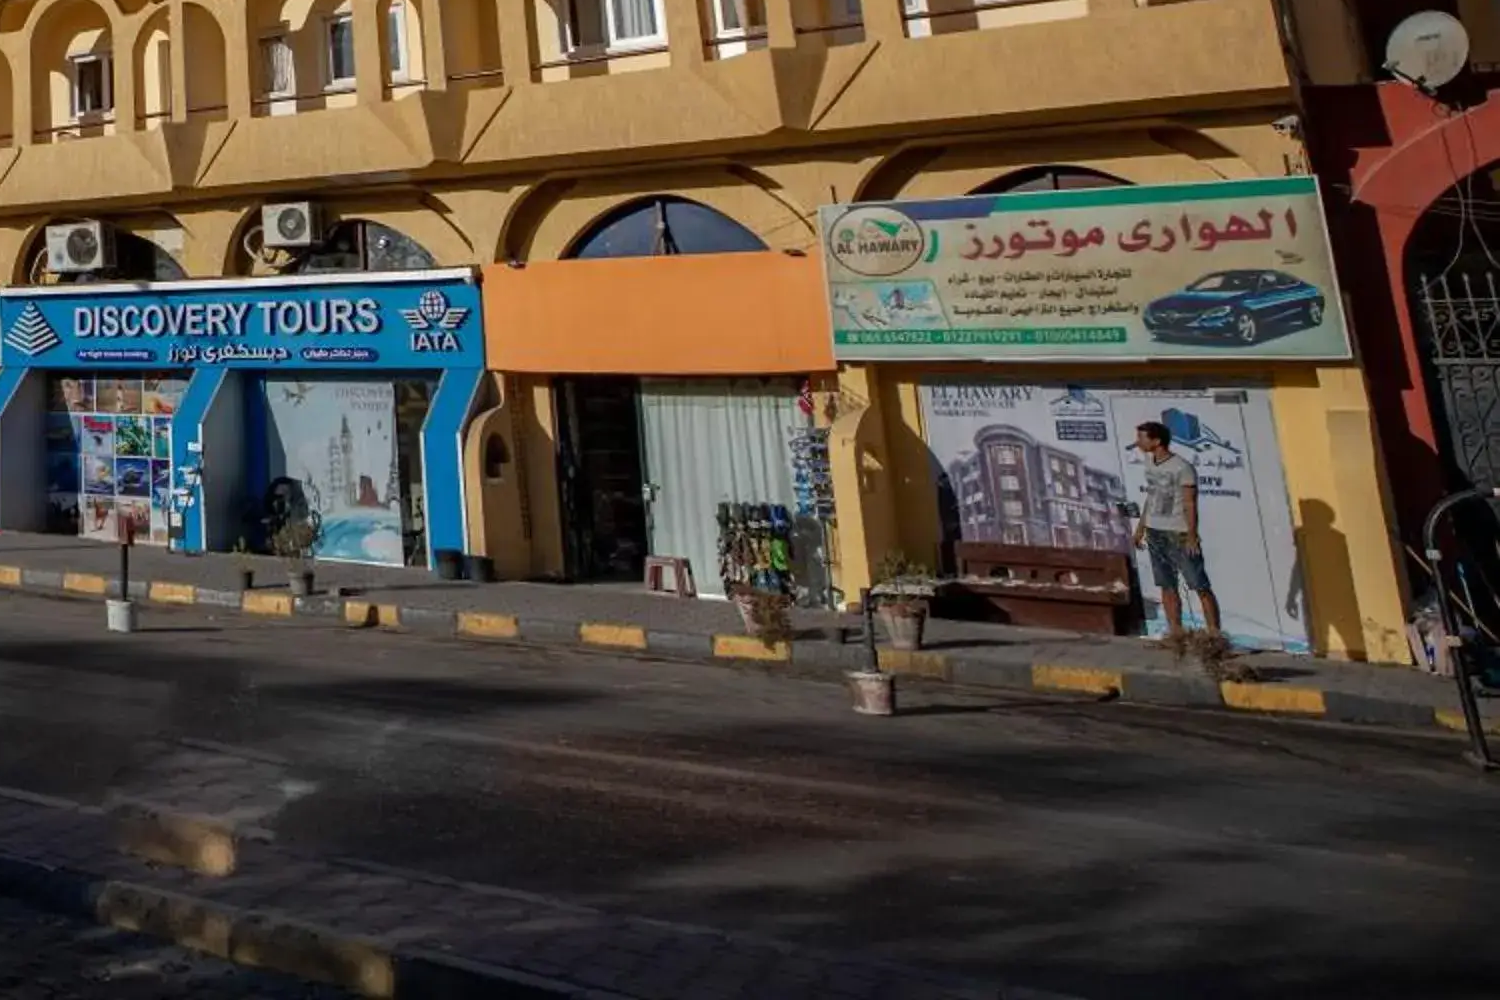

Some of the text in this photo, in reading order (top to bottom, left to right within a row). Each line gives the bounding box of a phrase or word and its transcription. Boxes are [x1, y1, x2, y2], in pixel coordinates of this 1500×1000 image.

[836, 239, 918, 255] AL HAWARY
[960, 218, 1105, 260] موتورز
[74, 298, 382, 339] DISCOVERY TOURS
[167, 341, 198, 363] تورز
[410, 331, 459, 352] IATA
[957, 384, 1036, 401] HAWARY
